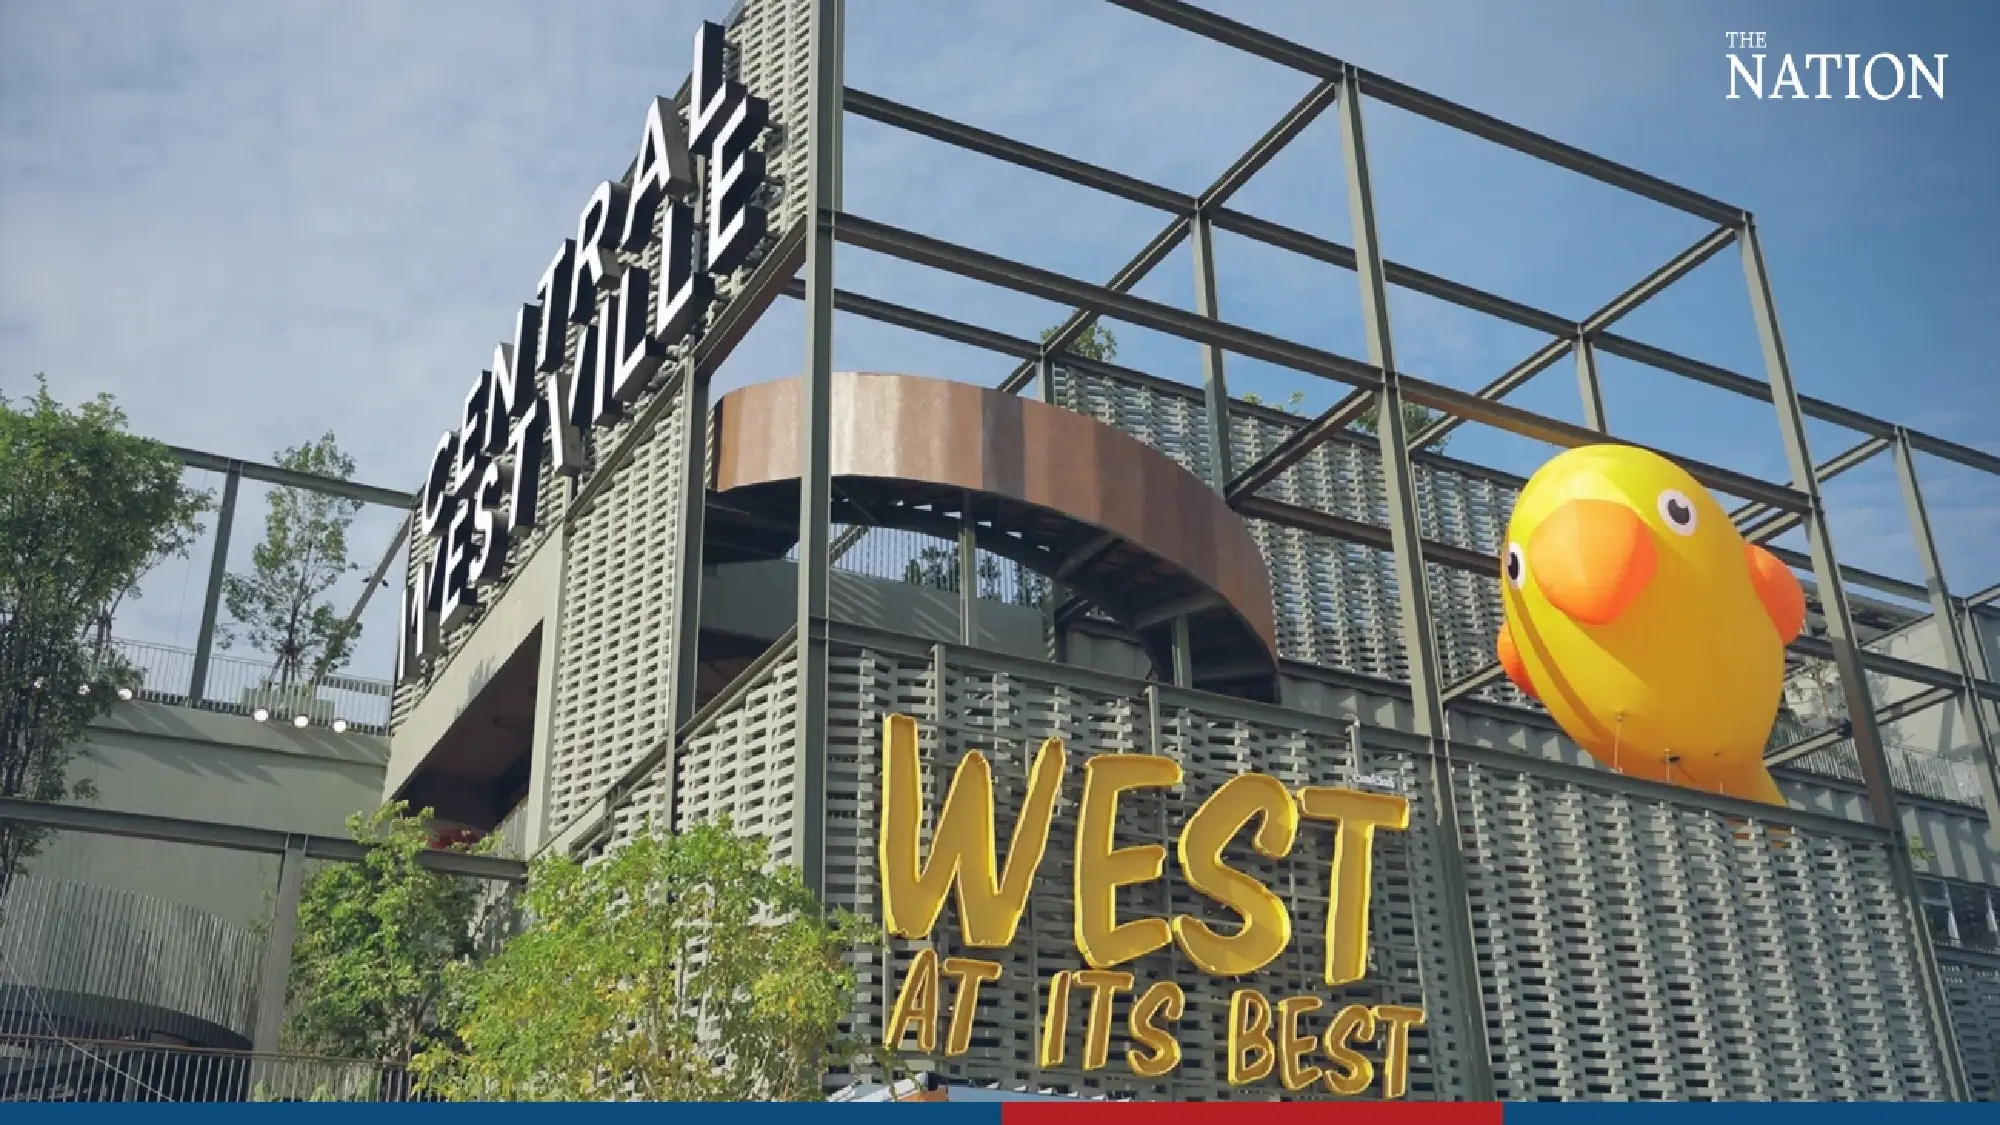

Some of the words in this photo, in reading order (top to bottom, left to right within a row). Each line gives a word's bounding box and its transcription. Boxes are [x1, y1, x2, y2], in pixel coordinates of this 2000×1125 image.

[396, 94, 769, 682] WESTVILLE
[422, 20, 748, 537] CENTRAL
[880, 713, 1409, 985] WEST
[884, 948, 1001, 1056] AT
[1041, 969, 1185, 1077] ITS
[1227, 988, 1426, 1099] BEST
